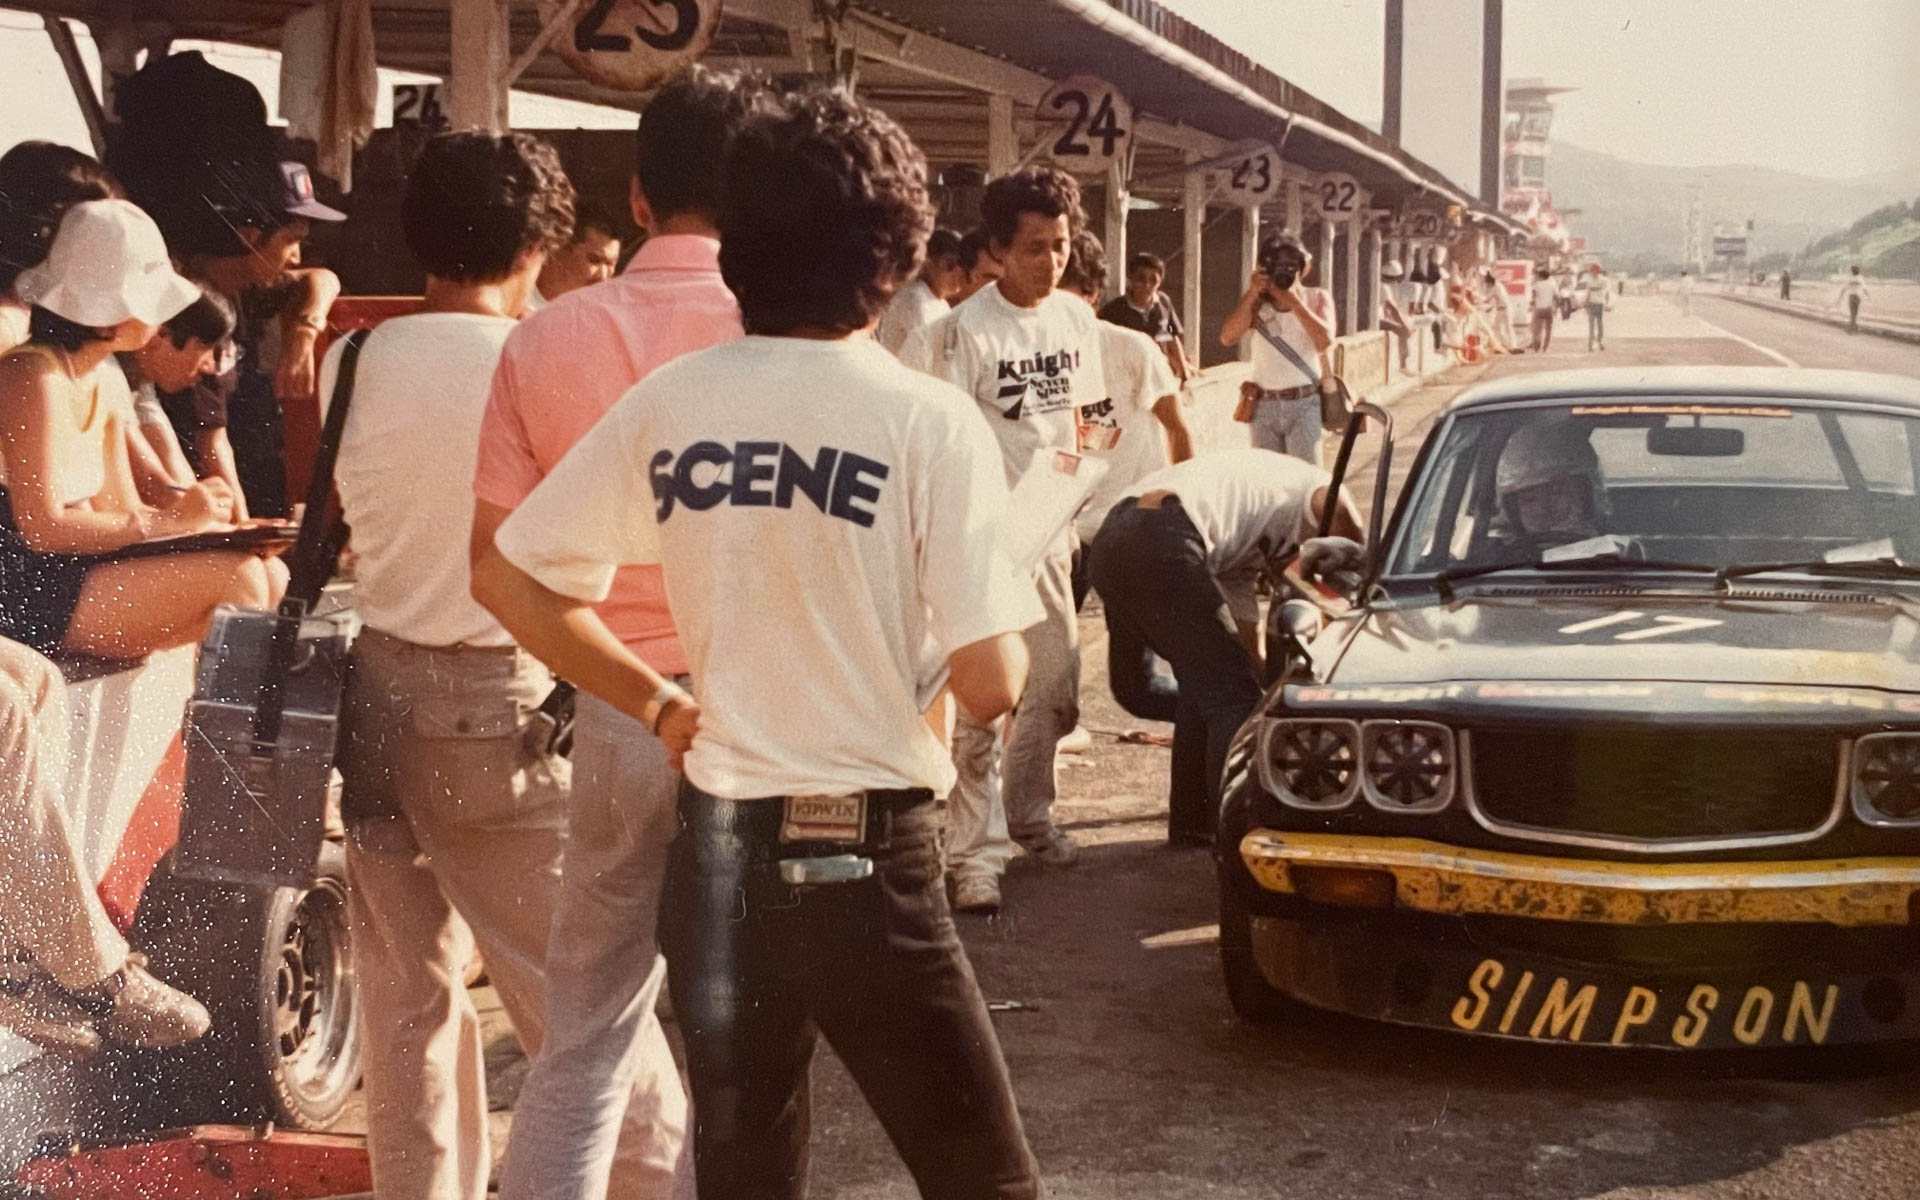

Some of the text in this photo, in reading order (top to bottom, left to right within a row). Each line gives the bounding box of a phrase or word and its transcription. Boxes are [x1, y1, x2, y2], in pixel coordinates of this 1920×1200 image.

[1052, 89, 1125, 157] 24
[1231, 154, 1270, 193] 23
[1321, 181, 1356, 212] 22
[649, 441, 889, 529] SCENE
[1451, 958, 1839, 1048] SIMPSON
